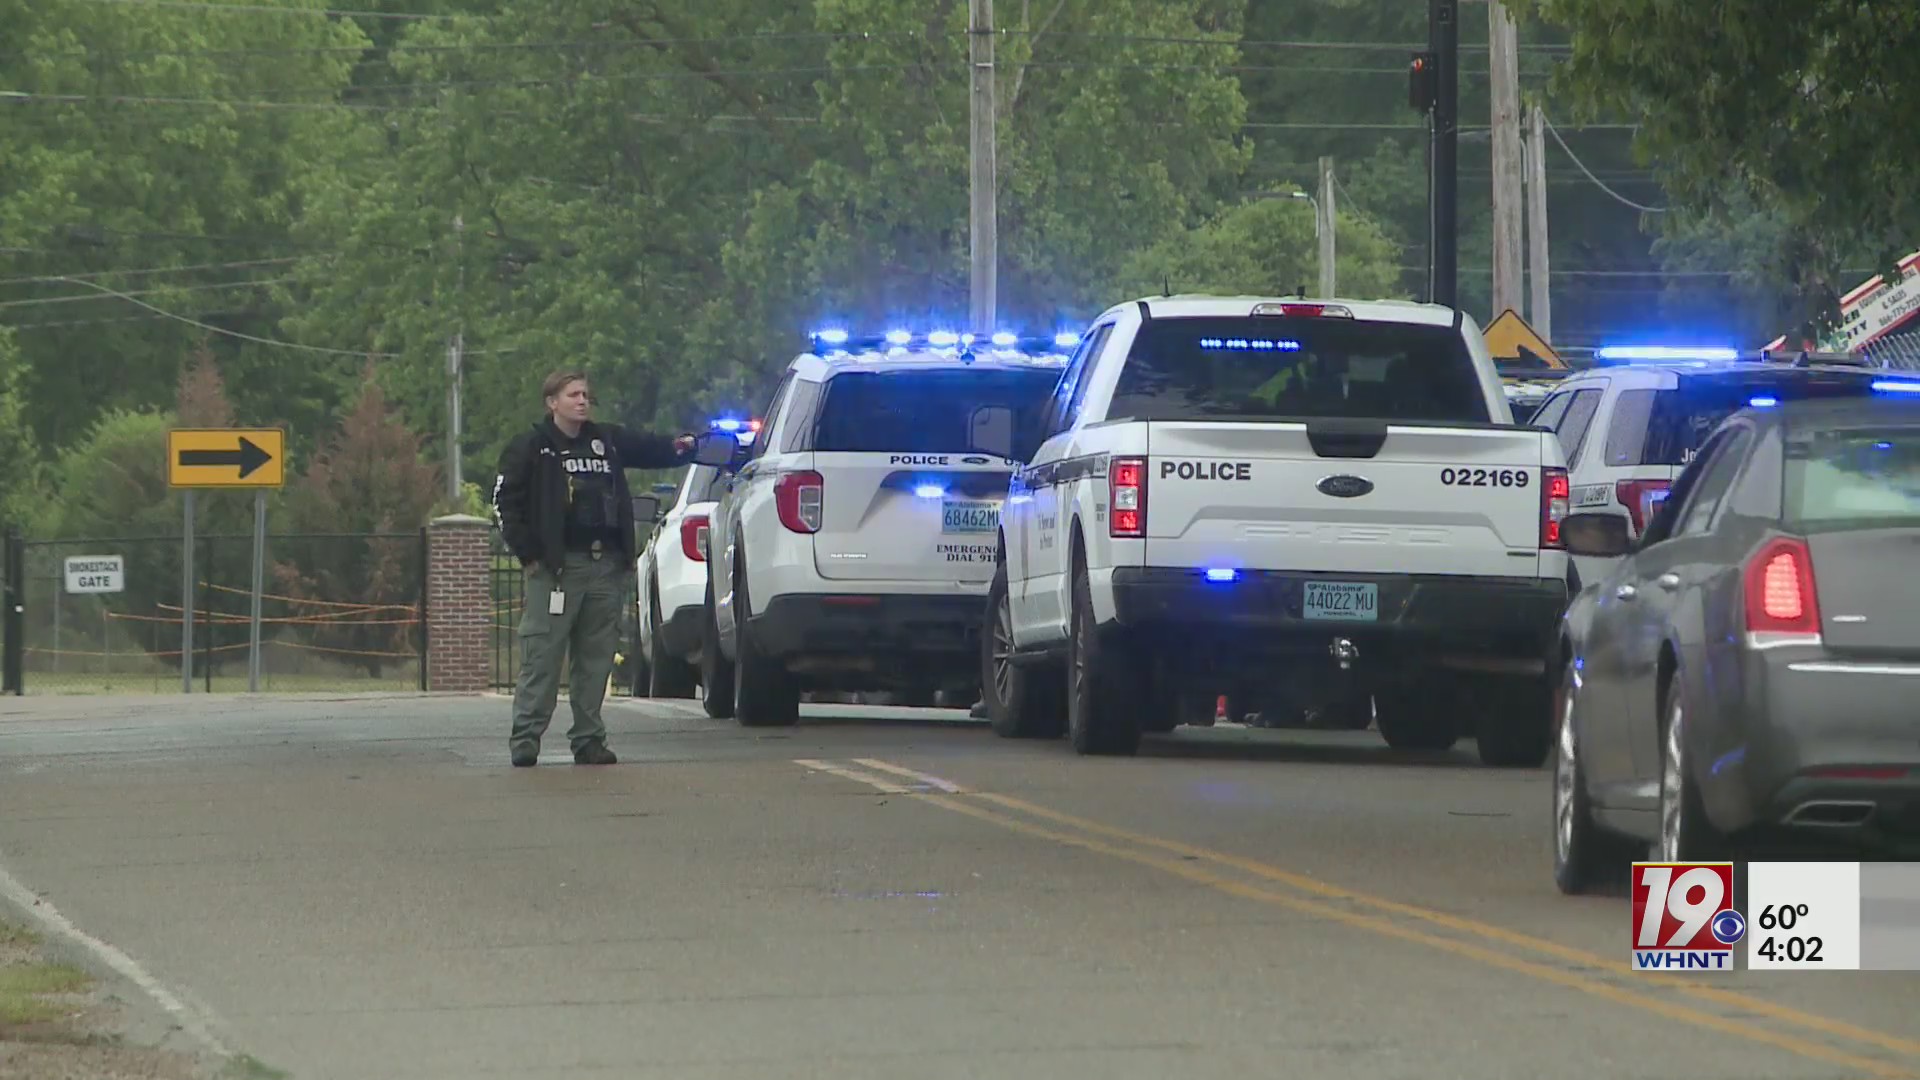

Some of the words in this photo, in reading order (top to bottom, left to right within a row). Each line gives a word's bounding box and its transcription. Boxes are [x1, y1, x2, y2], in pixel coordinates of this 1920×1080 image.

[890, 456, 948, 465] POLICE
[1161, 461, 1252, 481] POLICE
[1440, 468, 1529, 488] 022169
[947, 553, 974, 562] DIAL
[69, 561, 119, 573] SMOKESTACK
[79, 576, 110, 588] GATE
[1321, 583, 1362, 592] Alabama
[1307, 591, 1351, 610] 44022
[1355, 593, 1374, 611] MU
